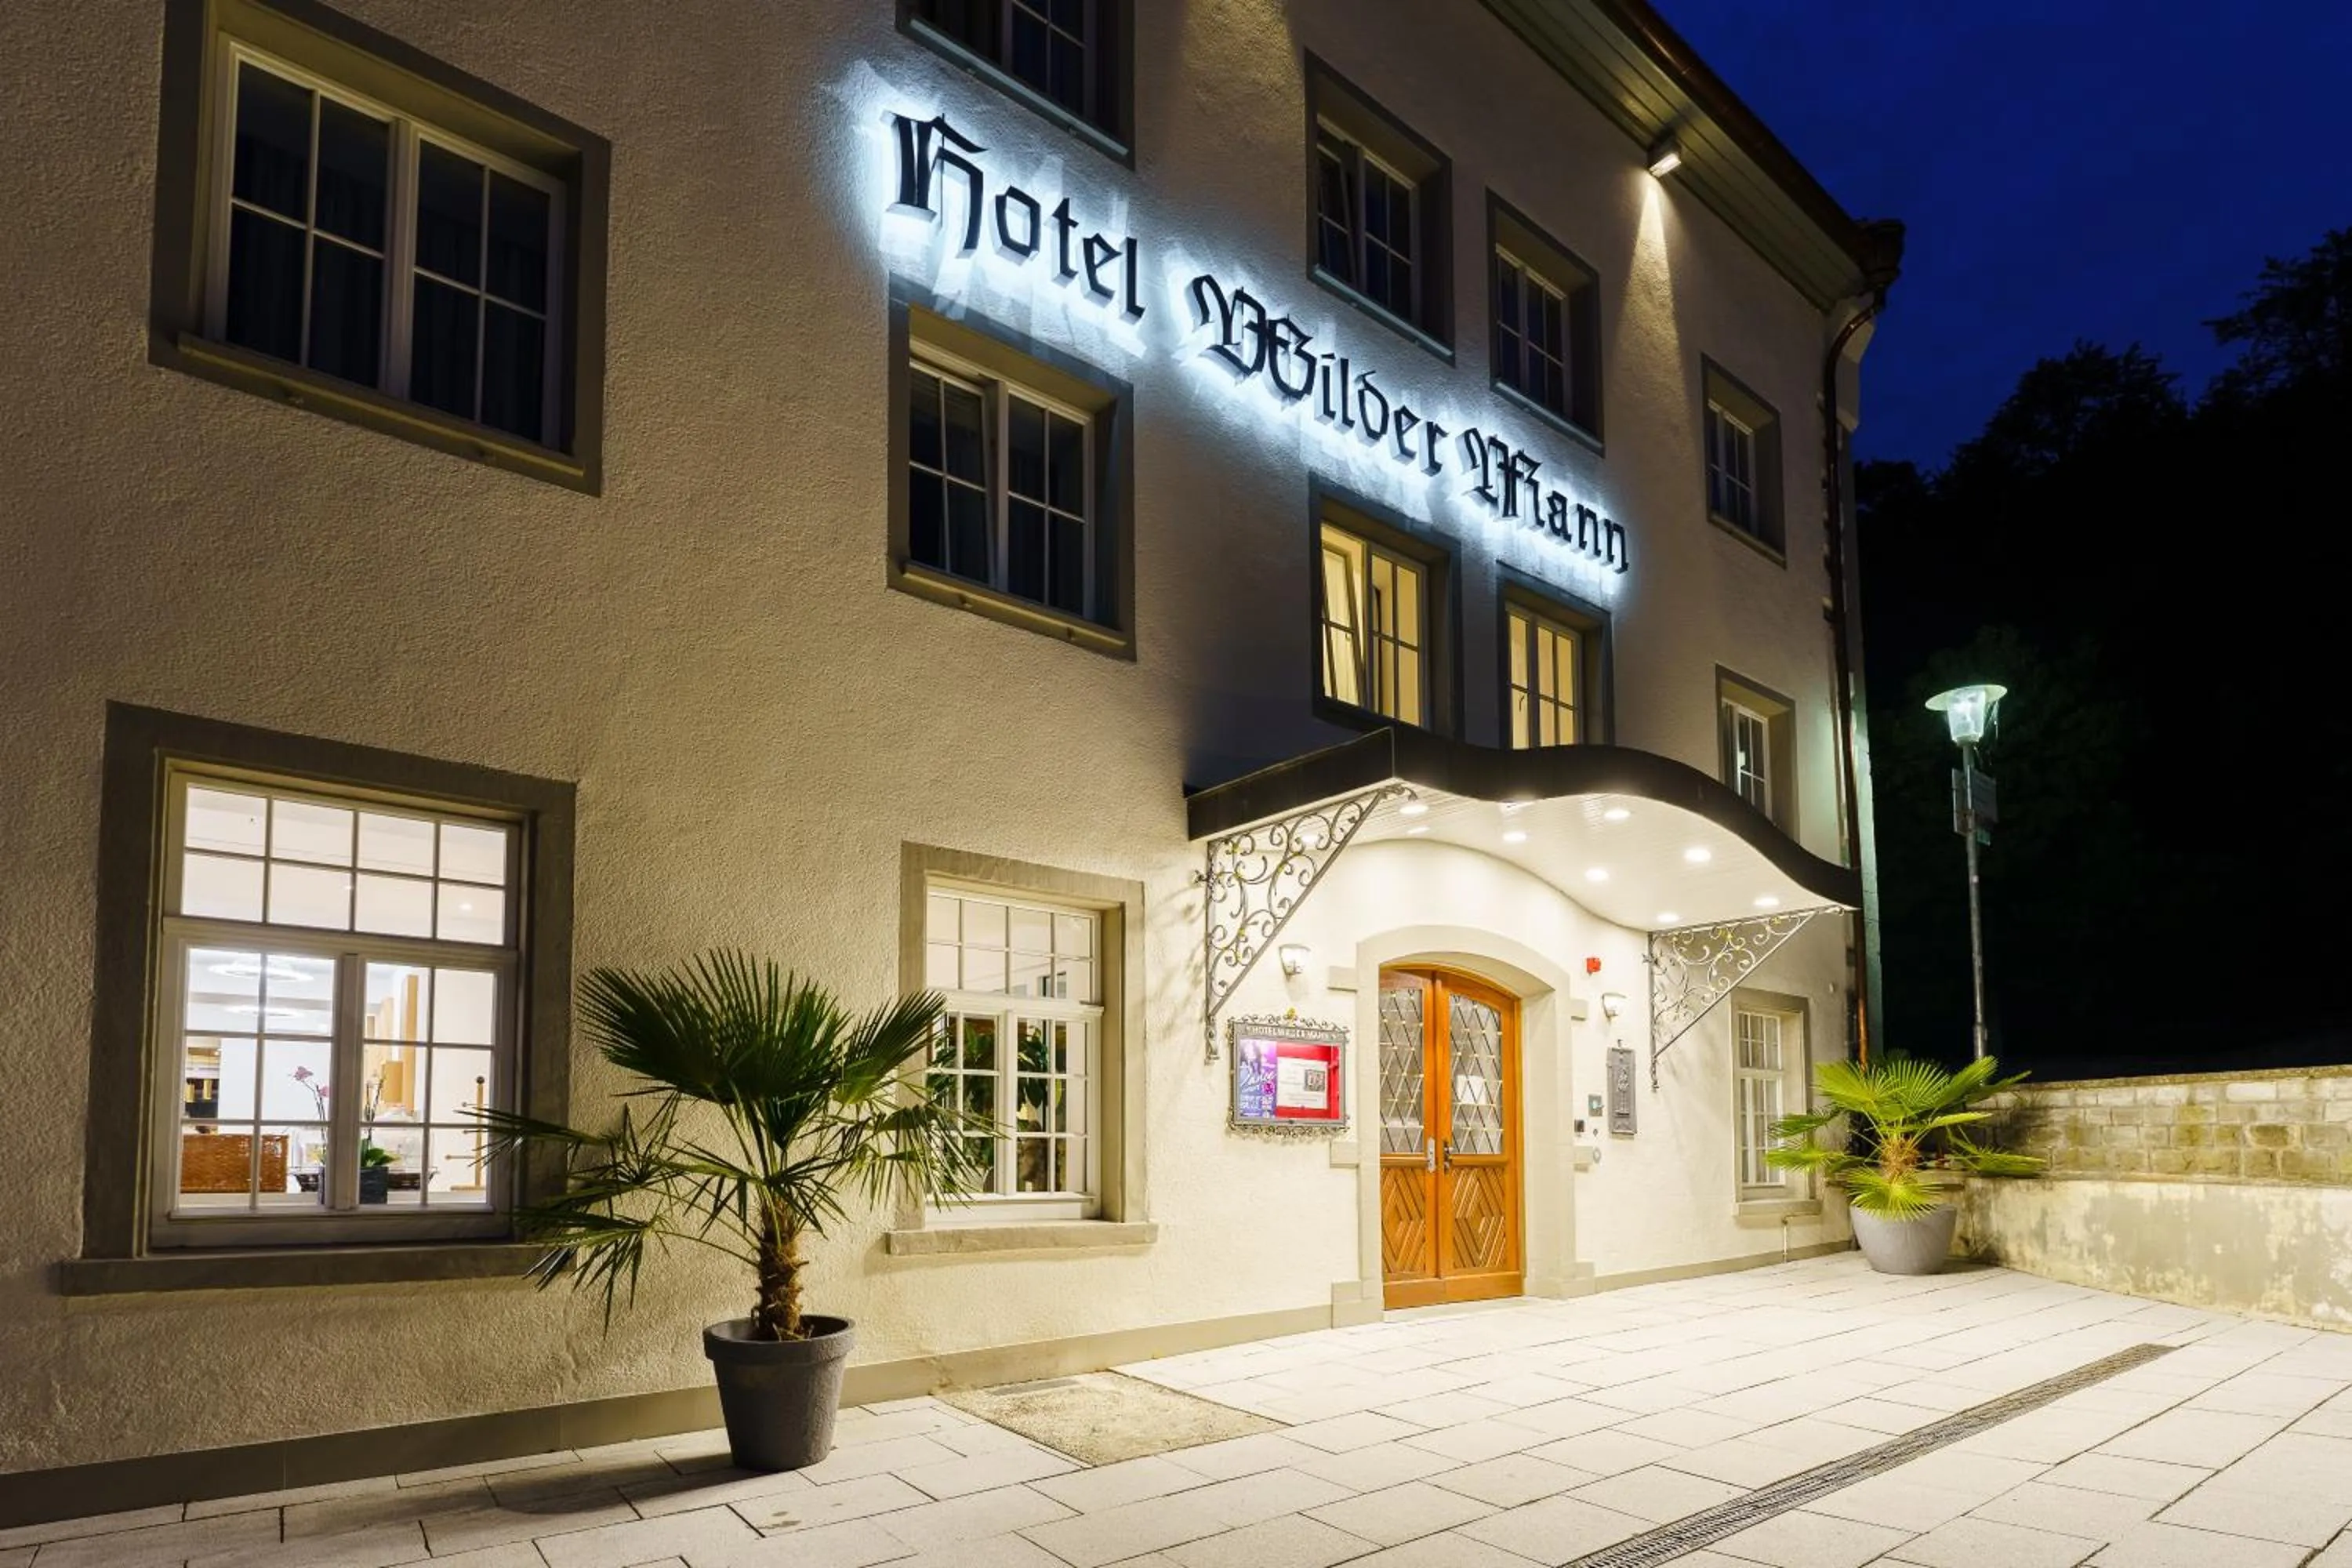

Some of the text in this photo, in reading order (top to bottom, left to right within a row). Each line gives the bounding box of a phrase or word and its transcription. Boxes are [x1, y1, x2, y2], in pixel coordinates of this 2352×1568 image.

[889, 111, 1629, 574] Hotel Wilder Mann
